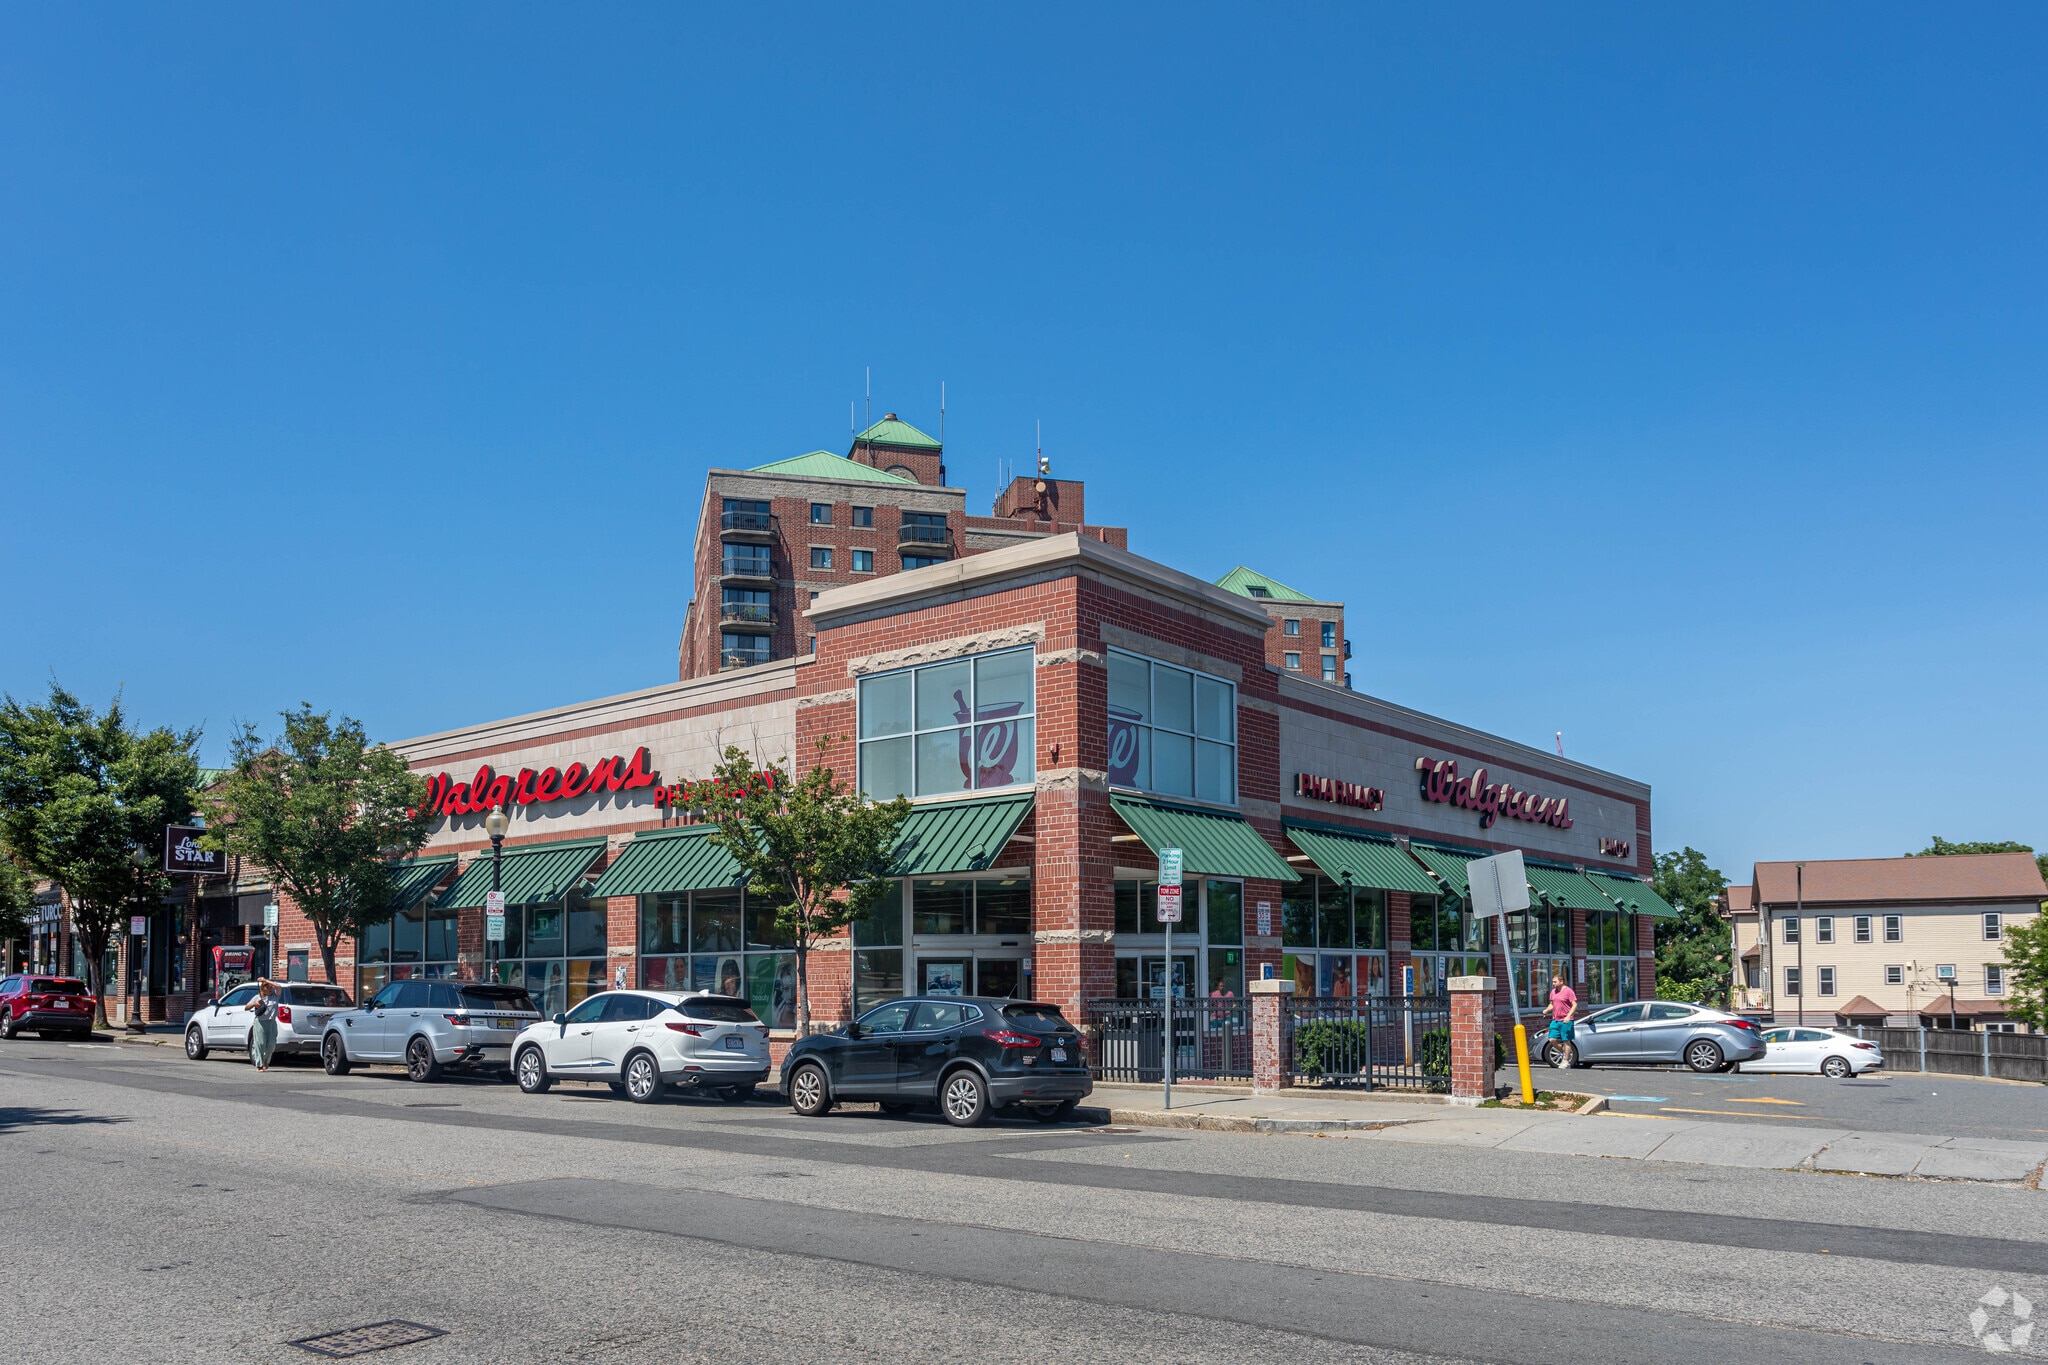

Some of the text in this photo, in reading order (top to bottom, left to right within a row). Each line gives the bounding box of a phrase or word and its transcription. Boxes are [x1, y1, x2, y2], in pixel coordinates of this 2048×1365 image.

[654, 769, 778, 809] PHAACY
[1297, 772, 1385, 811] PHARMACY
[1416, 757, 1573, 829] Walgreens
[175, 850, 214, 862] STAR
[752, 994, 769, 1002] beauty
